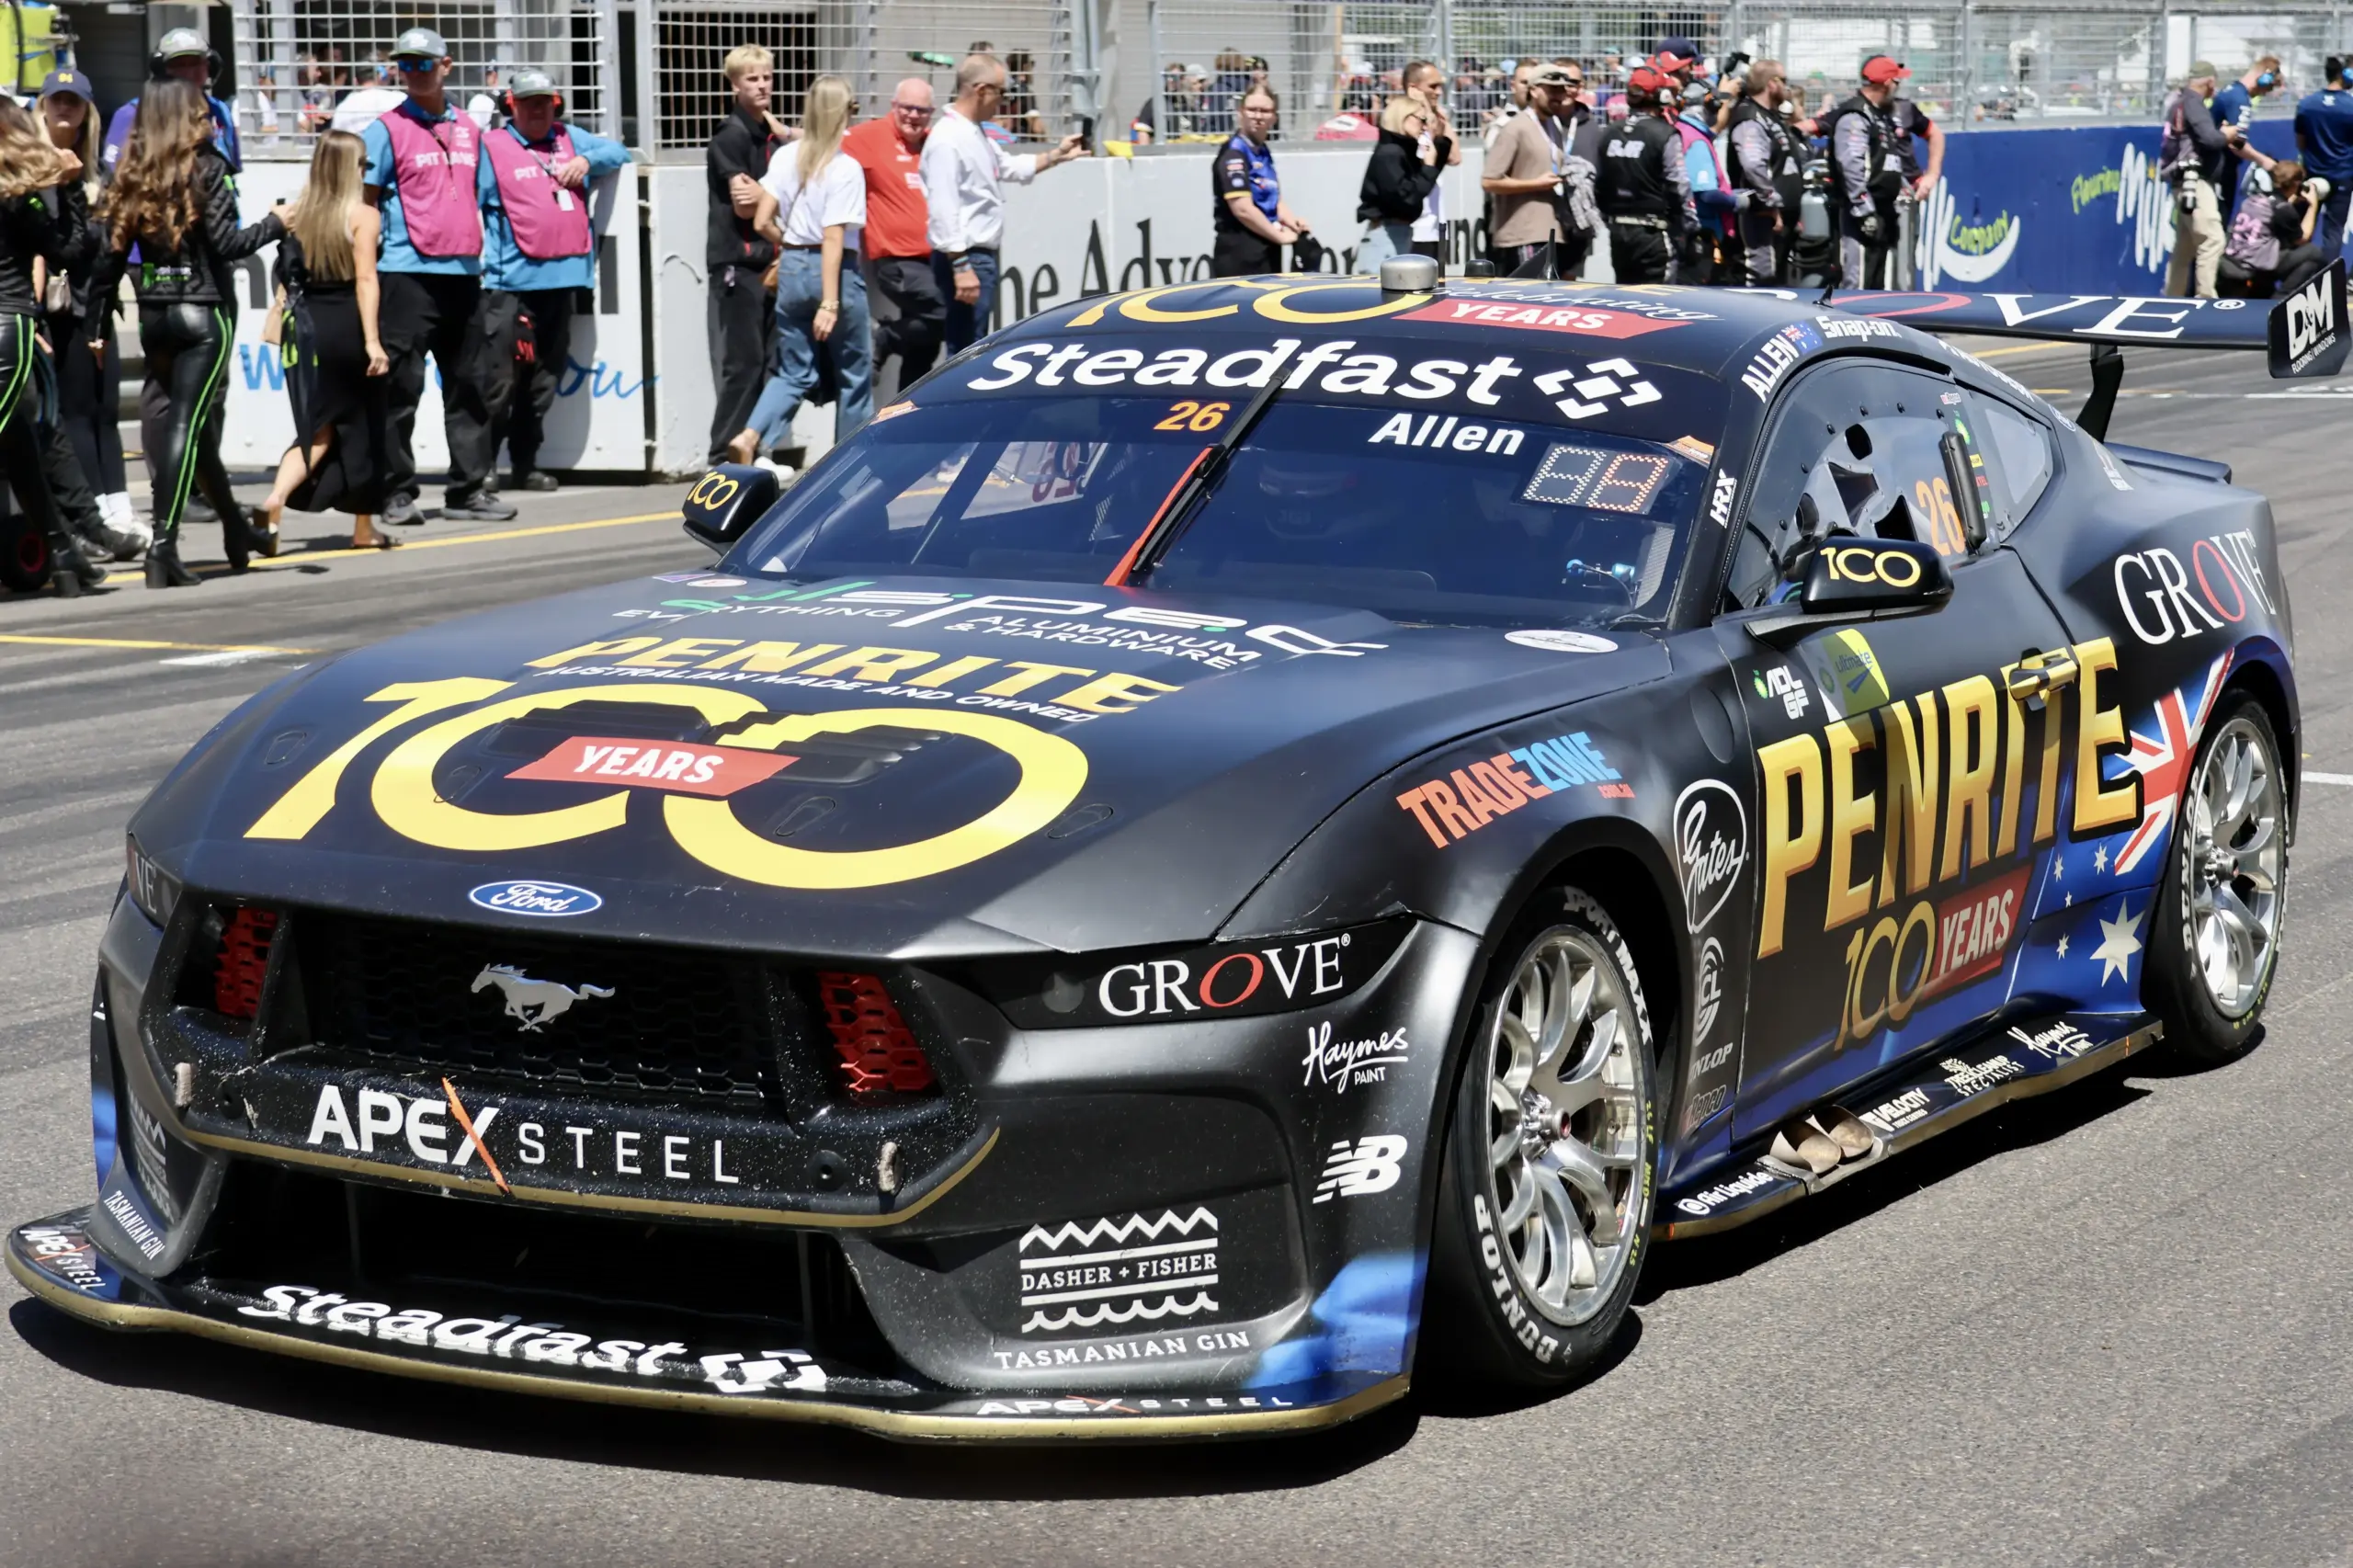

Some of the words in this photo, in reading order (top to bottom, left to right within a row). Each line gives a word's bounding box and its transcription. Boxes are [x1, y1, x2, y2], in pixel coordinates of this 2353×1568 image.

[415, 153, 440, 168] PIT
[514, 165, 538, 181] PIT
[1450, 302, 1614, 330] YEARS
[1815, 315, 1903, 342] Snap-on
[967, 338, 1523, 406] Steadfast
[1741, 333, 1800, 404] ALLEN
[1153, 401, 1232, 433] 26
[1368, 413, 1526, 457] Allen
[687, 471, 739, 511] 100
[1711, 468, 1735, 528] HRX
[1915, 476, 1968, 558] 26
[1820, 547, 1921, 588] 100
[944, 622, 976, 633] &
[983, 623, 1239, 670] HARDWARE
[970, 615, 1263, 663] ALUMINIUM
[523, 636, 1185, 713] PENRITE
[532, 666, 750, 683] AUSTRALIAN
[750, 674, 875, 691] MADE
[873, 685, 956, 700] AND
[955, 695, 1100, 723] OWNED
[243, 676, 1089, 890] 100
[574, 744, 724, 784] YEARS
[1396, 732, 1622, 849] TRADEZONE
[1756, 636, 2137, 961] PENRITE
[489, 881, 585, 915] Ford
[1834, 900, 1937, 1052] 100
[1938, 887, 2017, 980] YEARS
[1302, 1020, 1408, 1095] Haymes
[1354, 1066, 1386, 1086] PAINT
[1956, 1061, 2026, 1097] SPECIALIST
[308, 1077, 511, 1194] APEX
[517, 1121, 739, 1184] STEEL
[1696, 1190, 1729, 1207] Air
[1713, 1171, 1775, 1199] Liquide
[103, 1189, 150, 1247] TASMANIAN
[141, 1238, 166, 1261] GIN
[55, 1256, 107, 1290] STEEL
[1021, 1264, 1113, 1292] DASHER
[1137, 1252, 1219, 1280] FISHER
[1473, 1193, 1560, 1364] DUNLOP
[237, 1284, 688, 1376] Steadfast
[995, 1336, 1187, 1371] TASMANIAN
[1197, 1330, 1251, 1353] GIN
[975, 1394, 1142, 1416] APEX
[1140, 1395, 1296, 1410] STEEL
